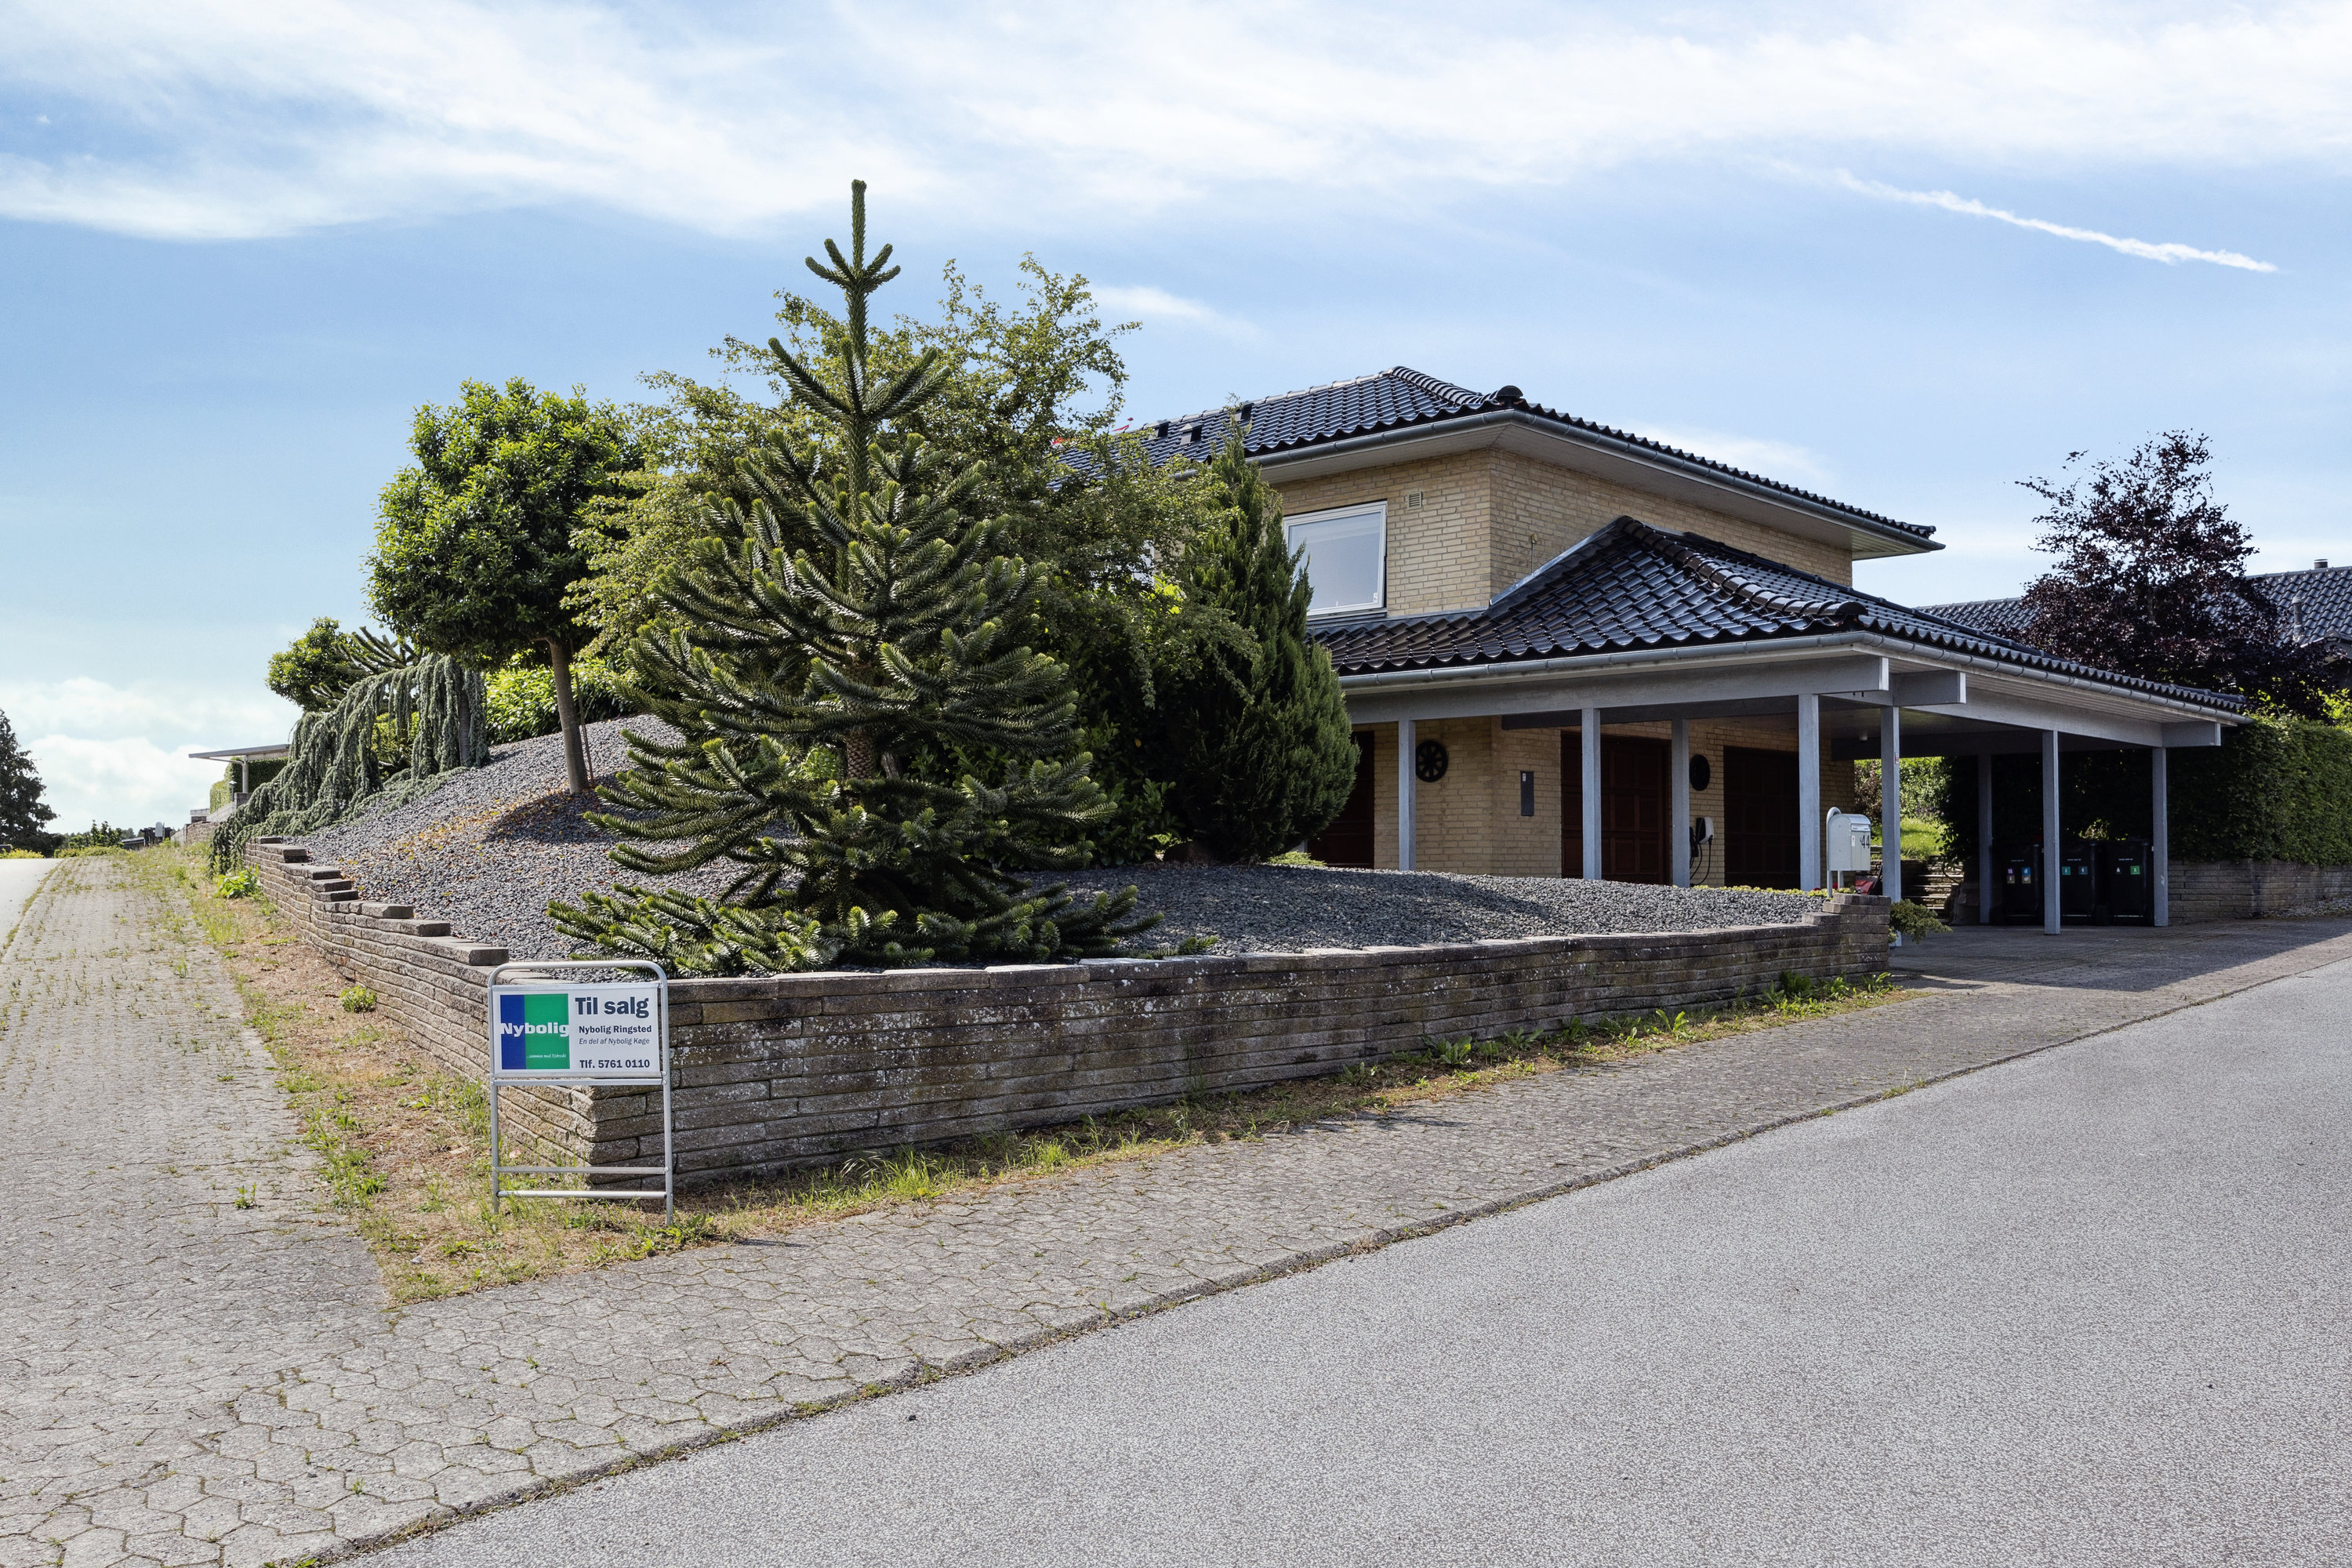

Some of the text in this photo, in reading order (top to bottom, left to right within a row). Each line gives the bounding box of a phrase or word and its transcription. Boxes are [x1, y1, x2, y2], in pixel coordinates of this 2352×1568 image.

[575, 996, 649, 1018] Til salg
[501, 1022, 570, 1037] Nybolig
[579, 1025, 652, 1035] Nybolig Ringsted
[608, 1037, 632, 1046] Nybolig
[633, 1037, 650, 1046] Køge
[579, 1059, 651, 1069] Tlf. 5761 0110
